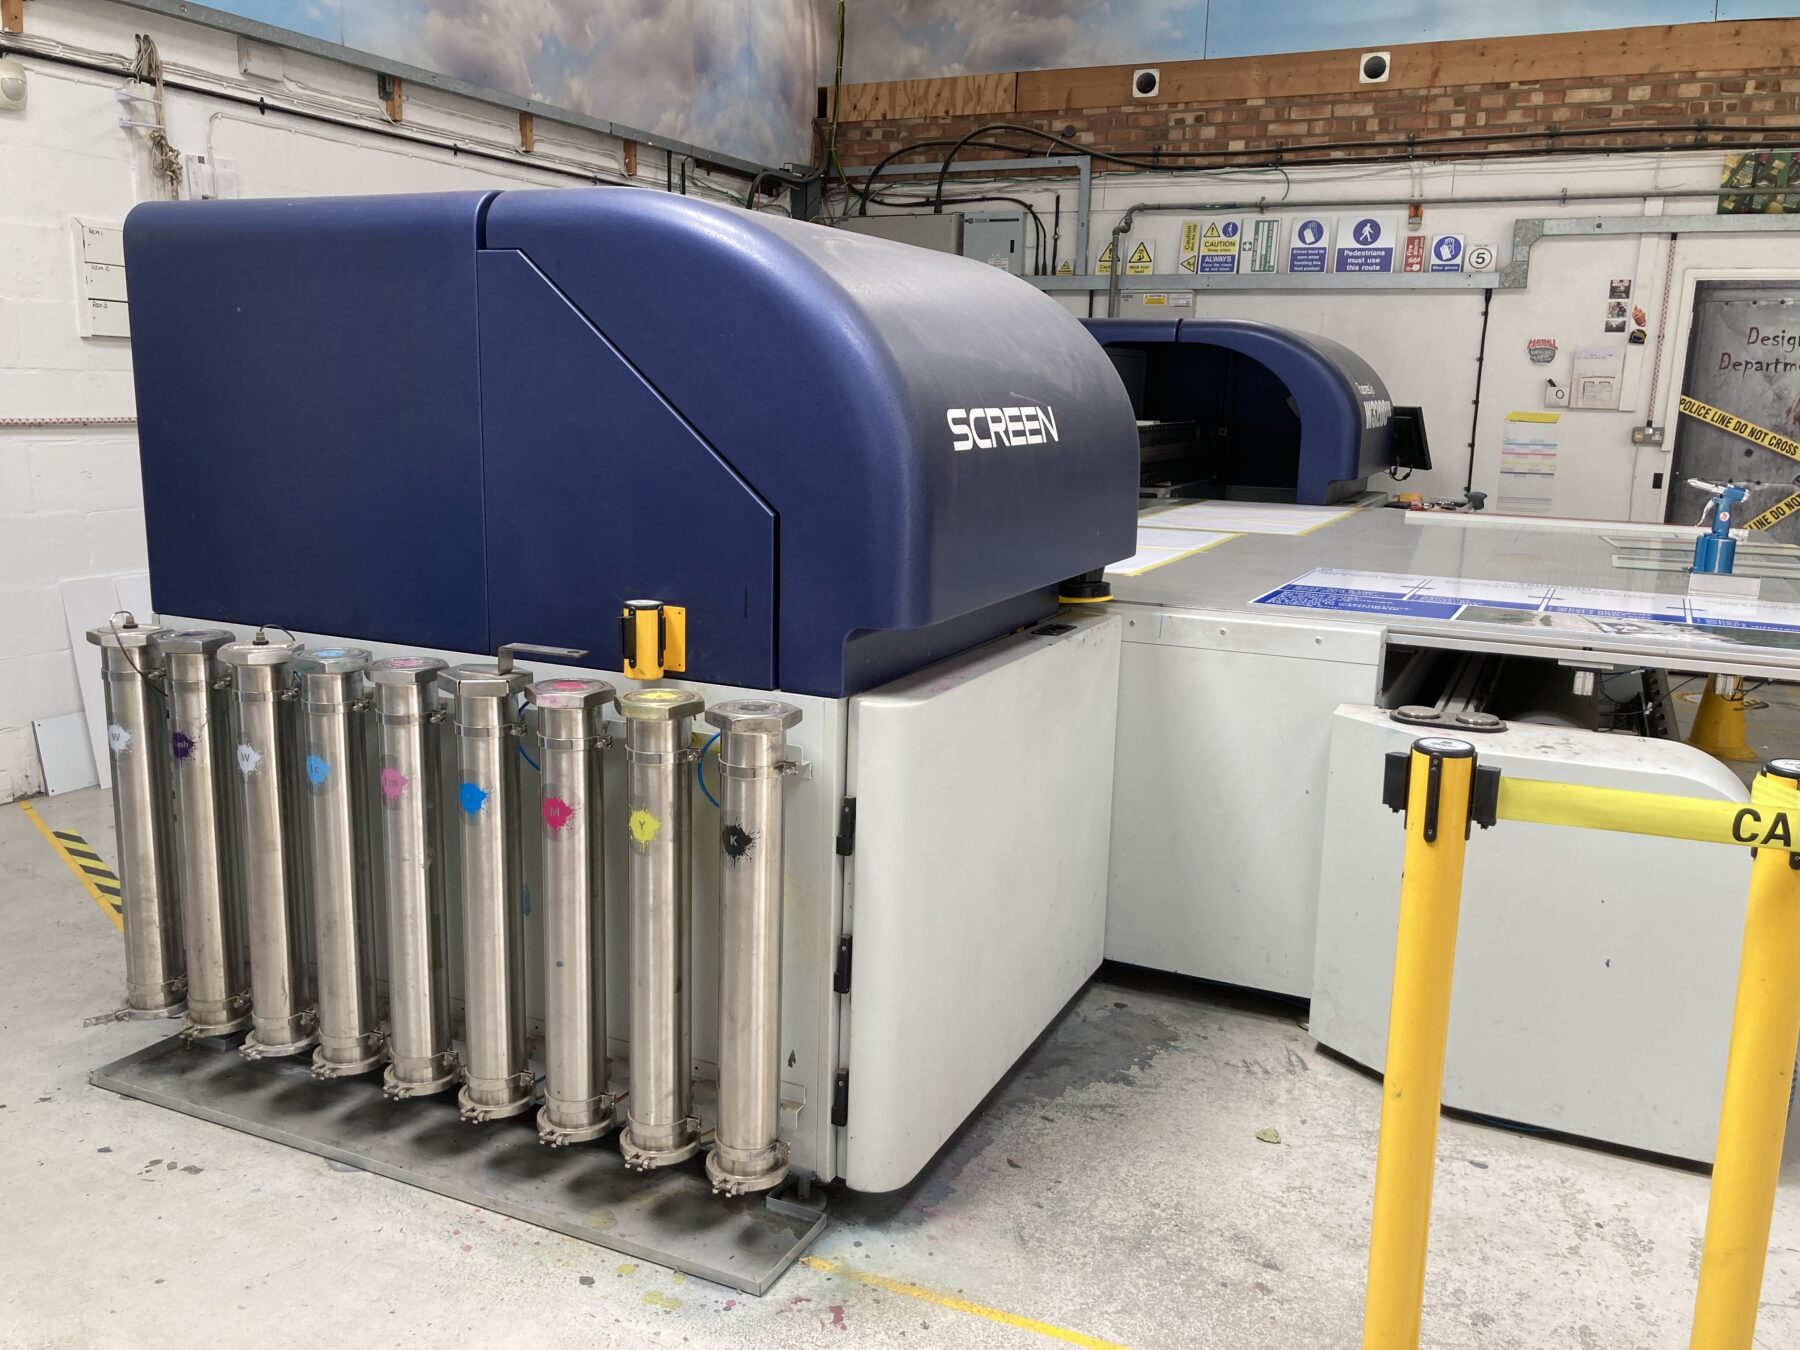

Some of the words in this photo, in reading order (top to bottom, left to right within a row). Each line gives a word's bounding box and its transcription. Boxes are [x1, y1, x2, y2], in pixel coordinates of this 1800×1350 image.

[1184, 225, 1192, 250] Caution
[1475, 252, 1485, 264] 5
[1719, 352, 1800, 378] Departm
[947, 406, 1059, 451] SCREEN
[1680, 397, 1712, 420] POLICE
[1711, 409, 1733, 429] LINE
[1732, 421, 1748, 434] DO
[1748, 426, 1769, 444] NOT
[1768, 436, 1799, 456] CROSS
[1769, 506, 1786, 520] DO
[241, 753, 250, 762] W
[639, 820, 646, 830] Y
[1732, 808, 1792, 848] CA
[730, 835, 738, 846] K
